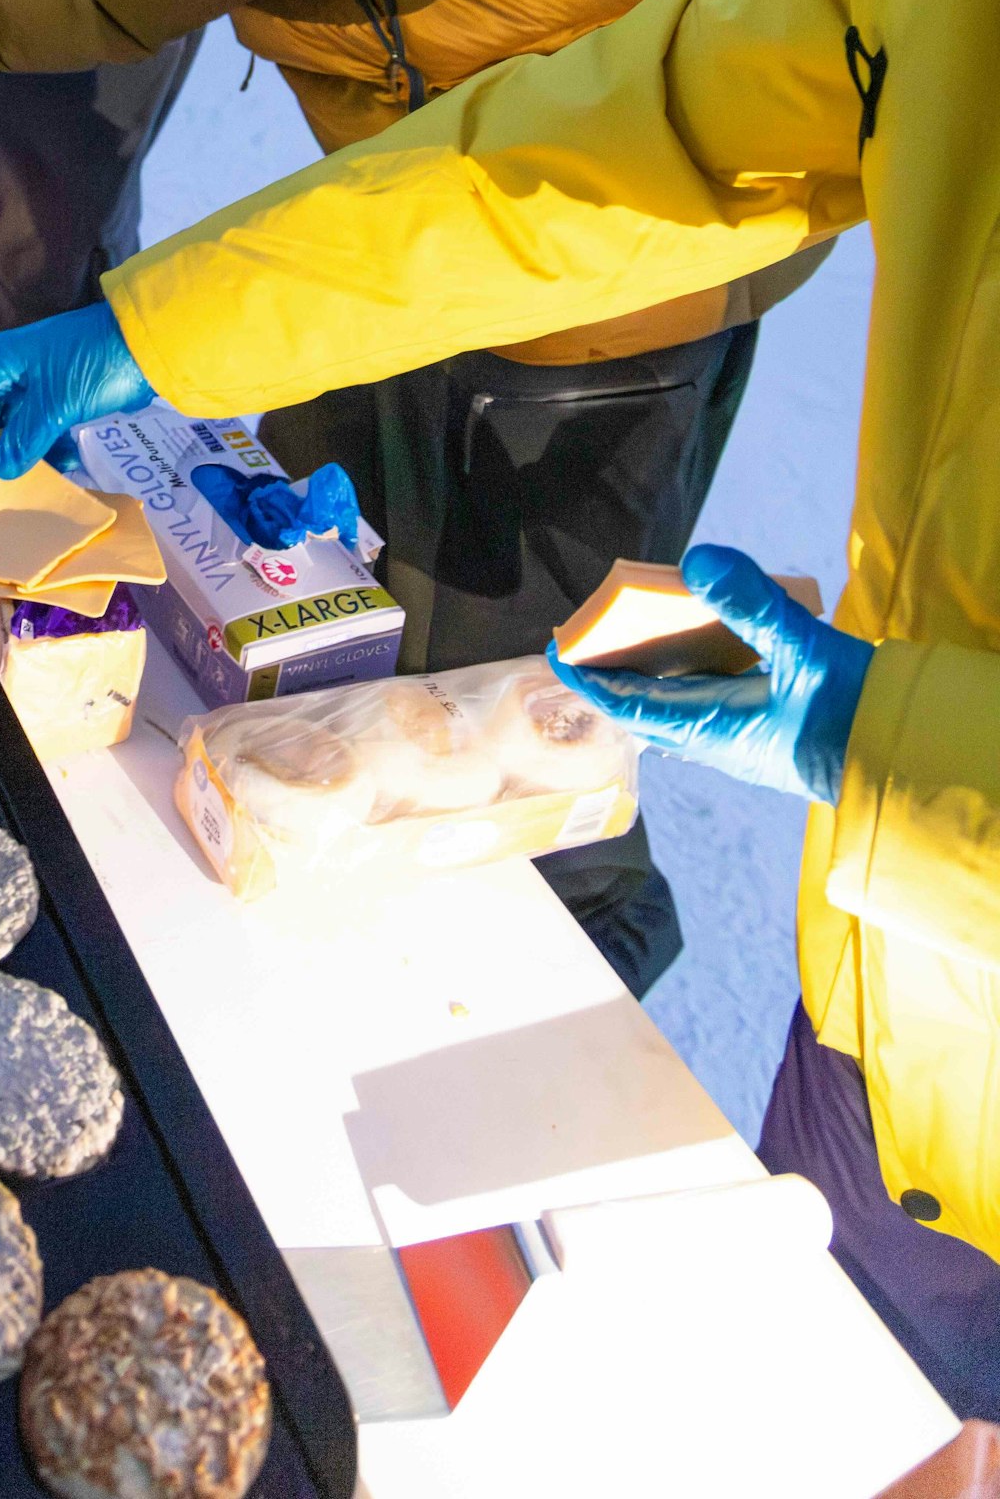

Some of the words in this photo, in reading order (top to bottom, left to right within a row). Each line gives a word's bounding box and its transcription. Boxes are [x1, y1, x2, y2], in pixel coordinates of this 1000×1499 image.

[96, 425, 176, 512] GLOVES
[128, 422, 188, 489] Multi-Purpose
[168, 514, 236, 592] VINYL
[248, 589, 379, 638] X-LARGE
[335, 643, 392, 665] GLOVES
